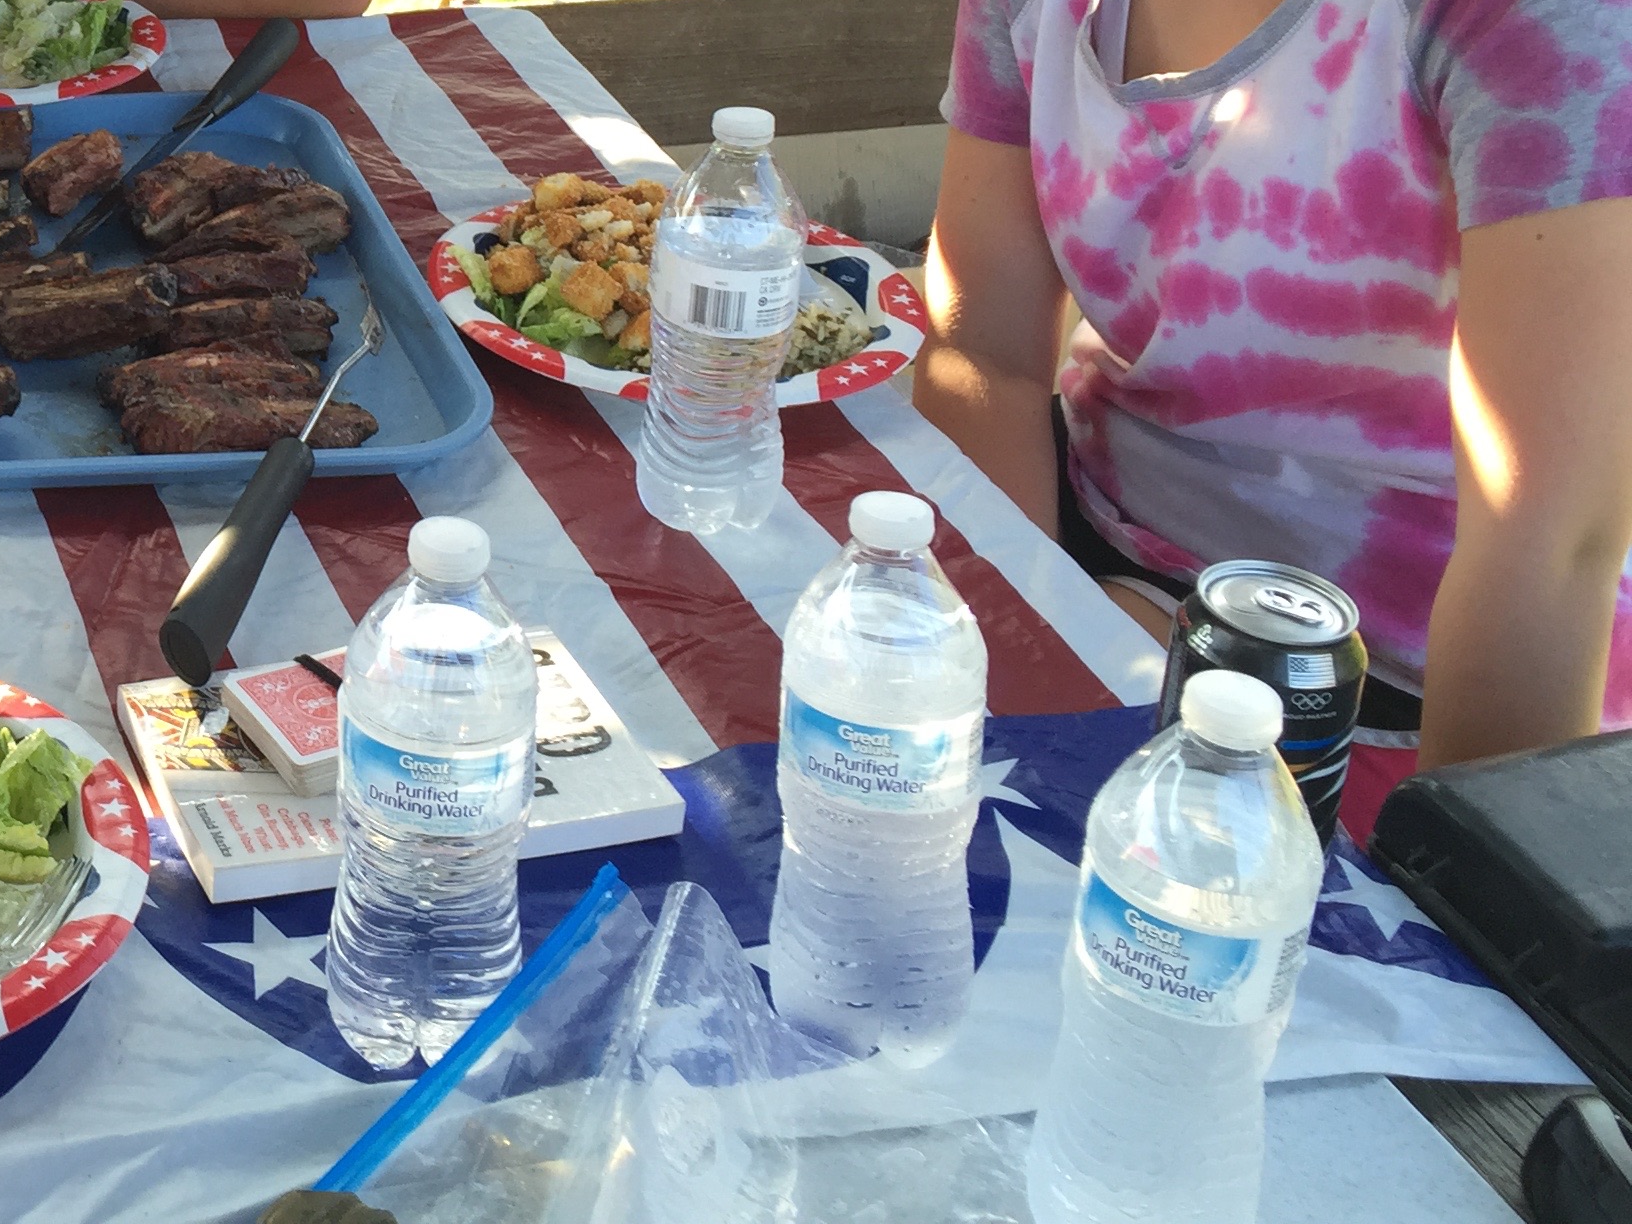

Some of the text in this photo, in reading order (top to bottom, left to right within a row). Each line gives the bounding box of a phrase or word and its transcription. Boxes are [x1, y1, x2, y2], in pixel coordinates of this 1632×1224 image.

[838, 725, 891, 748] Great
[399, 754, 450, 775] Great
[808, 755, 926, 793] Drinking Water
[834, 752, 898, 777] Purified
[369, 784, 484, 819] Drinking Water
[395, 781, 458, 804] Purified
[1124, 909, 1183, 948] Great
[1090, 932, 1218, 1003] Drinking Water
[1115, 936, 1187, 980] Purified
